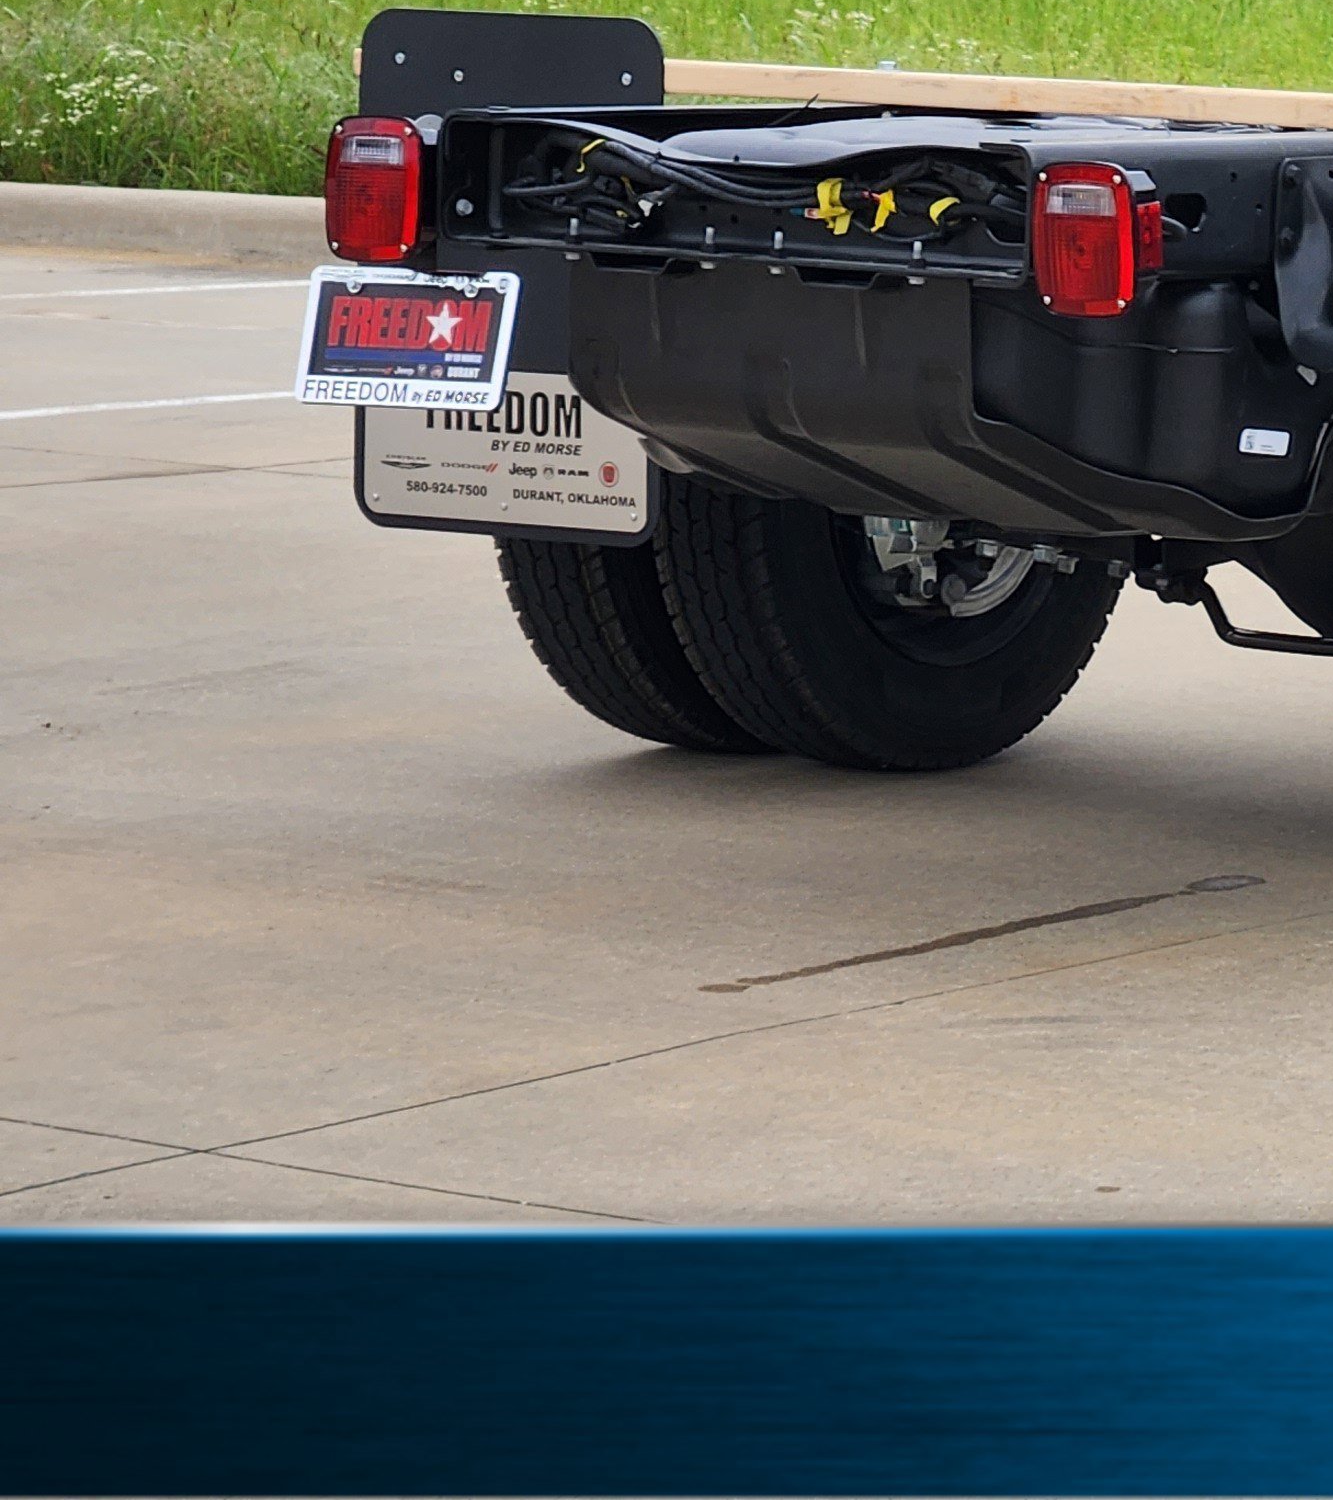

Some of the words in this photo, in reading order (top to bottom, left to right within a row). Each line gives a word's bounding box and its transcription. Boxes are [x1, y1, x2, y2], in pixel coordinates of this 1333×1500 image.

[303, 379, 409, 404] FREEDOM
[425, 389, 442, 403] ED
[445, 391, 489, 405] MORSE
[491, 439, 510, 451] BY
[513, 441, 531, 453] ED
[534, 443, 583, 456] MORSE
[509, 463, 538, 478] Jeep
[558, 468, 590, 477] RAM
[406, 480, 488, 497] 580-924-7500
[512, 488, 564, 505] DURANT,
[568, 492, 637, 508] OKLAHOMA
